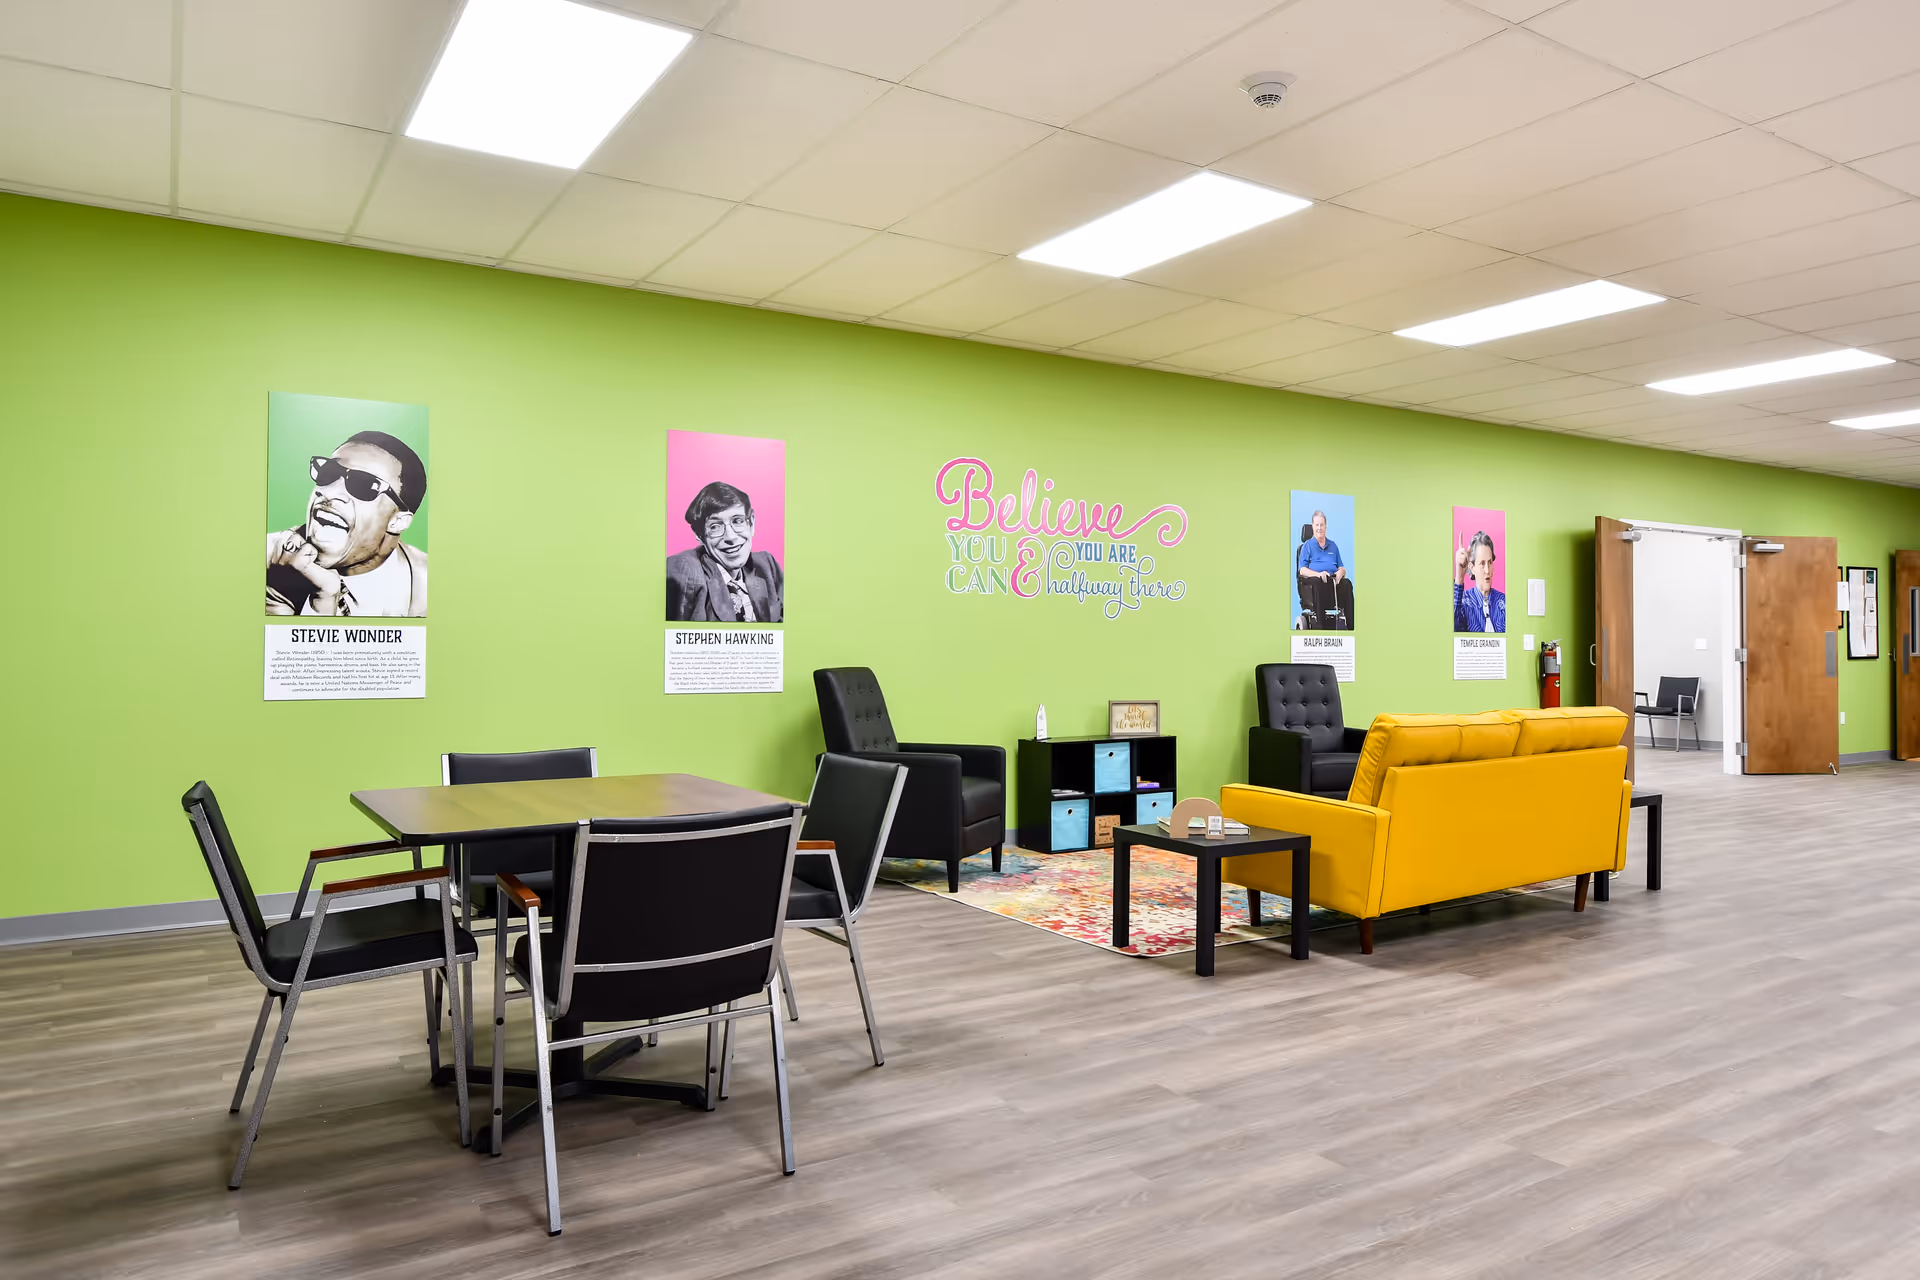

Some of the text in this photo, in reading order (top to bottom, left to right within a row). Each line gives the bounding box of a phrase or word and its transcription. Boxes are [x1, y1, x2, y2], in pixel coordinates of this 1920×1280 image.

[935, 457, 1188, 547] Believe
[945, 534, 1006, 563] YOU
[1074, 542, 1137, 564] YOU ARE
[945, 565, 1008, 595] CAN
[1047, 540, 1187, 620] halfway there
[291, 628, 402, 643] STEVIE WONDER
[675, 632, 774, 645] STEPHEN HAWKING
[1303, 637, 1343, 647] RALPH BRAUN
[1460, 639, 1500, 647] TEMPLE GRANDIN
